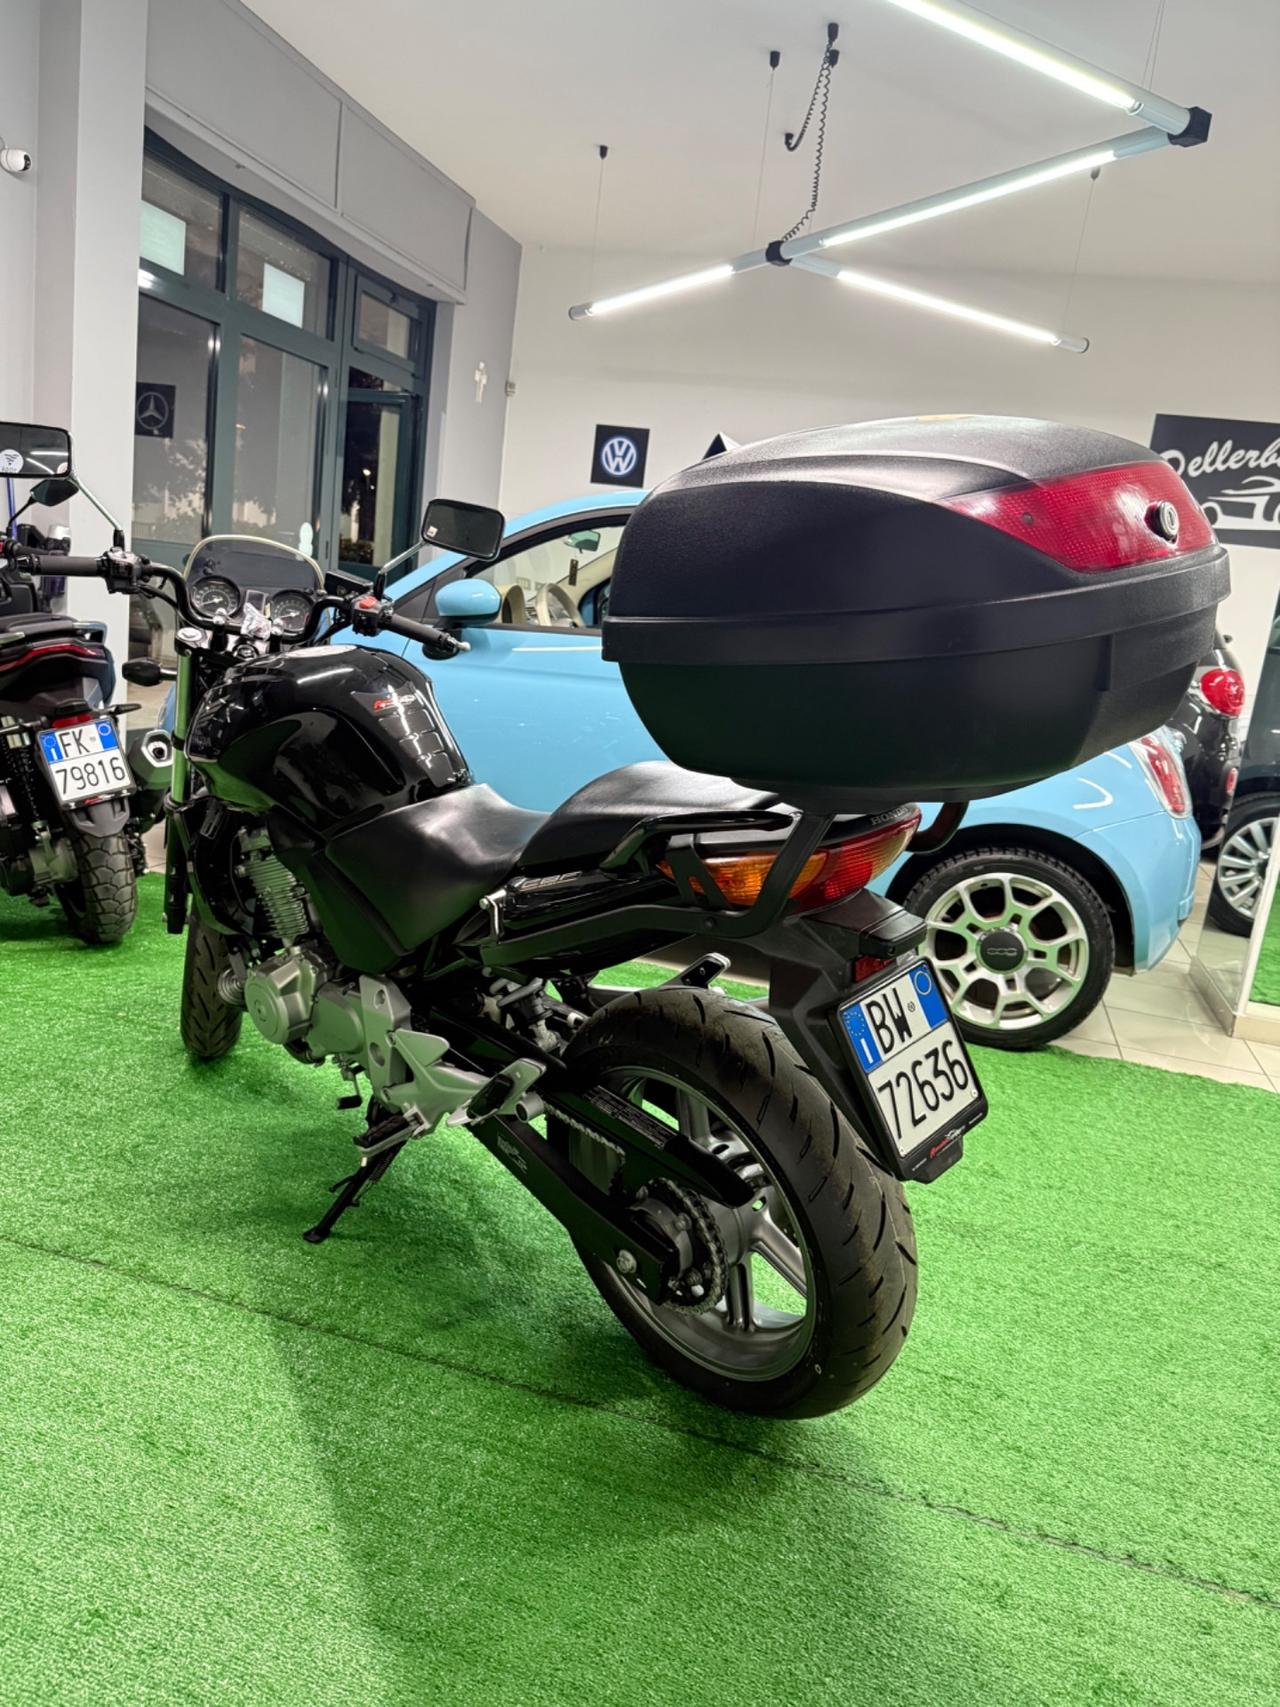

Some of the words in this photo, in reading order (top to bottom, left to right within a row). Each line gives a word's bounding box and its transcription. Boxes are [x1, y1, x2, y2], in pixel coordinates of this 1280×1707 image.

[58, 729, 90, 758] FK
[55, 757, 126, 795] 79816
[869, 806, 909, 826] HONDA
[865, 987, 913, 1055] BW
[877, 1039, 969, 1140] 72636
